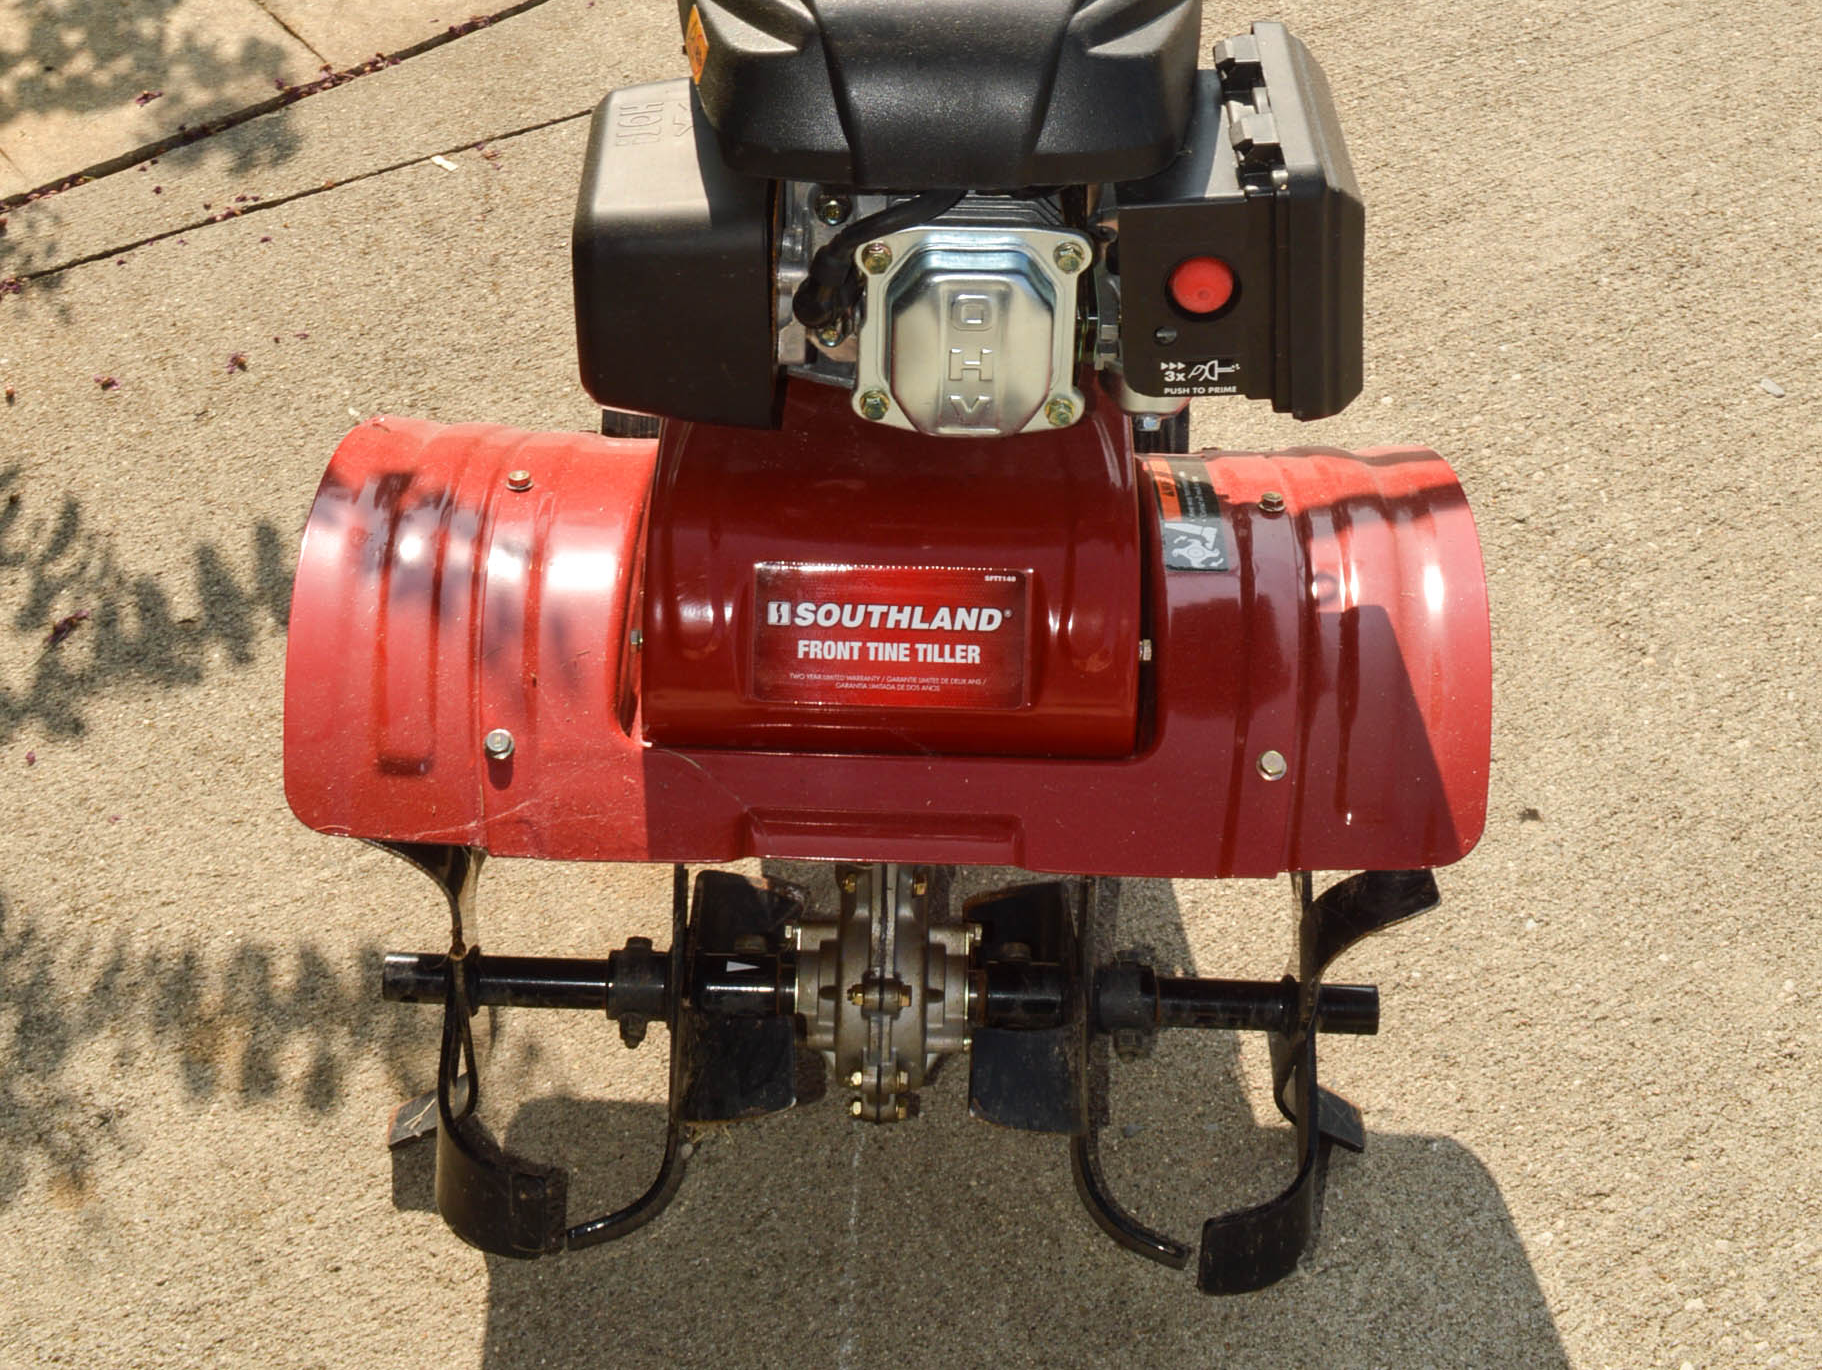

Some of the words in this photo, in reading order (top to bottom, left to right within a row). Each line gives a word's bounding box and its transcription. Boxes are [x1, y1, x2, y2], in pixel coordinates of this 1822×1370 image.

[1164, 371, 1187, 382] 3x
[1164, 387, 1190, 395] PUSH
[1192, 387, 1205, 395] TO
[794, 602, 1003, 632] SOUTHLAND
[797, 640, 862, 661] FRONT
[866, 642, 911, 663] TINE
[915, 643, 981, 664] TILLER
